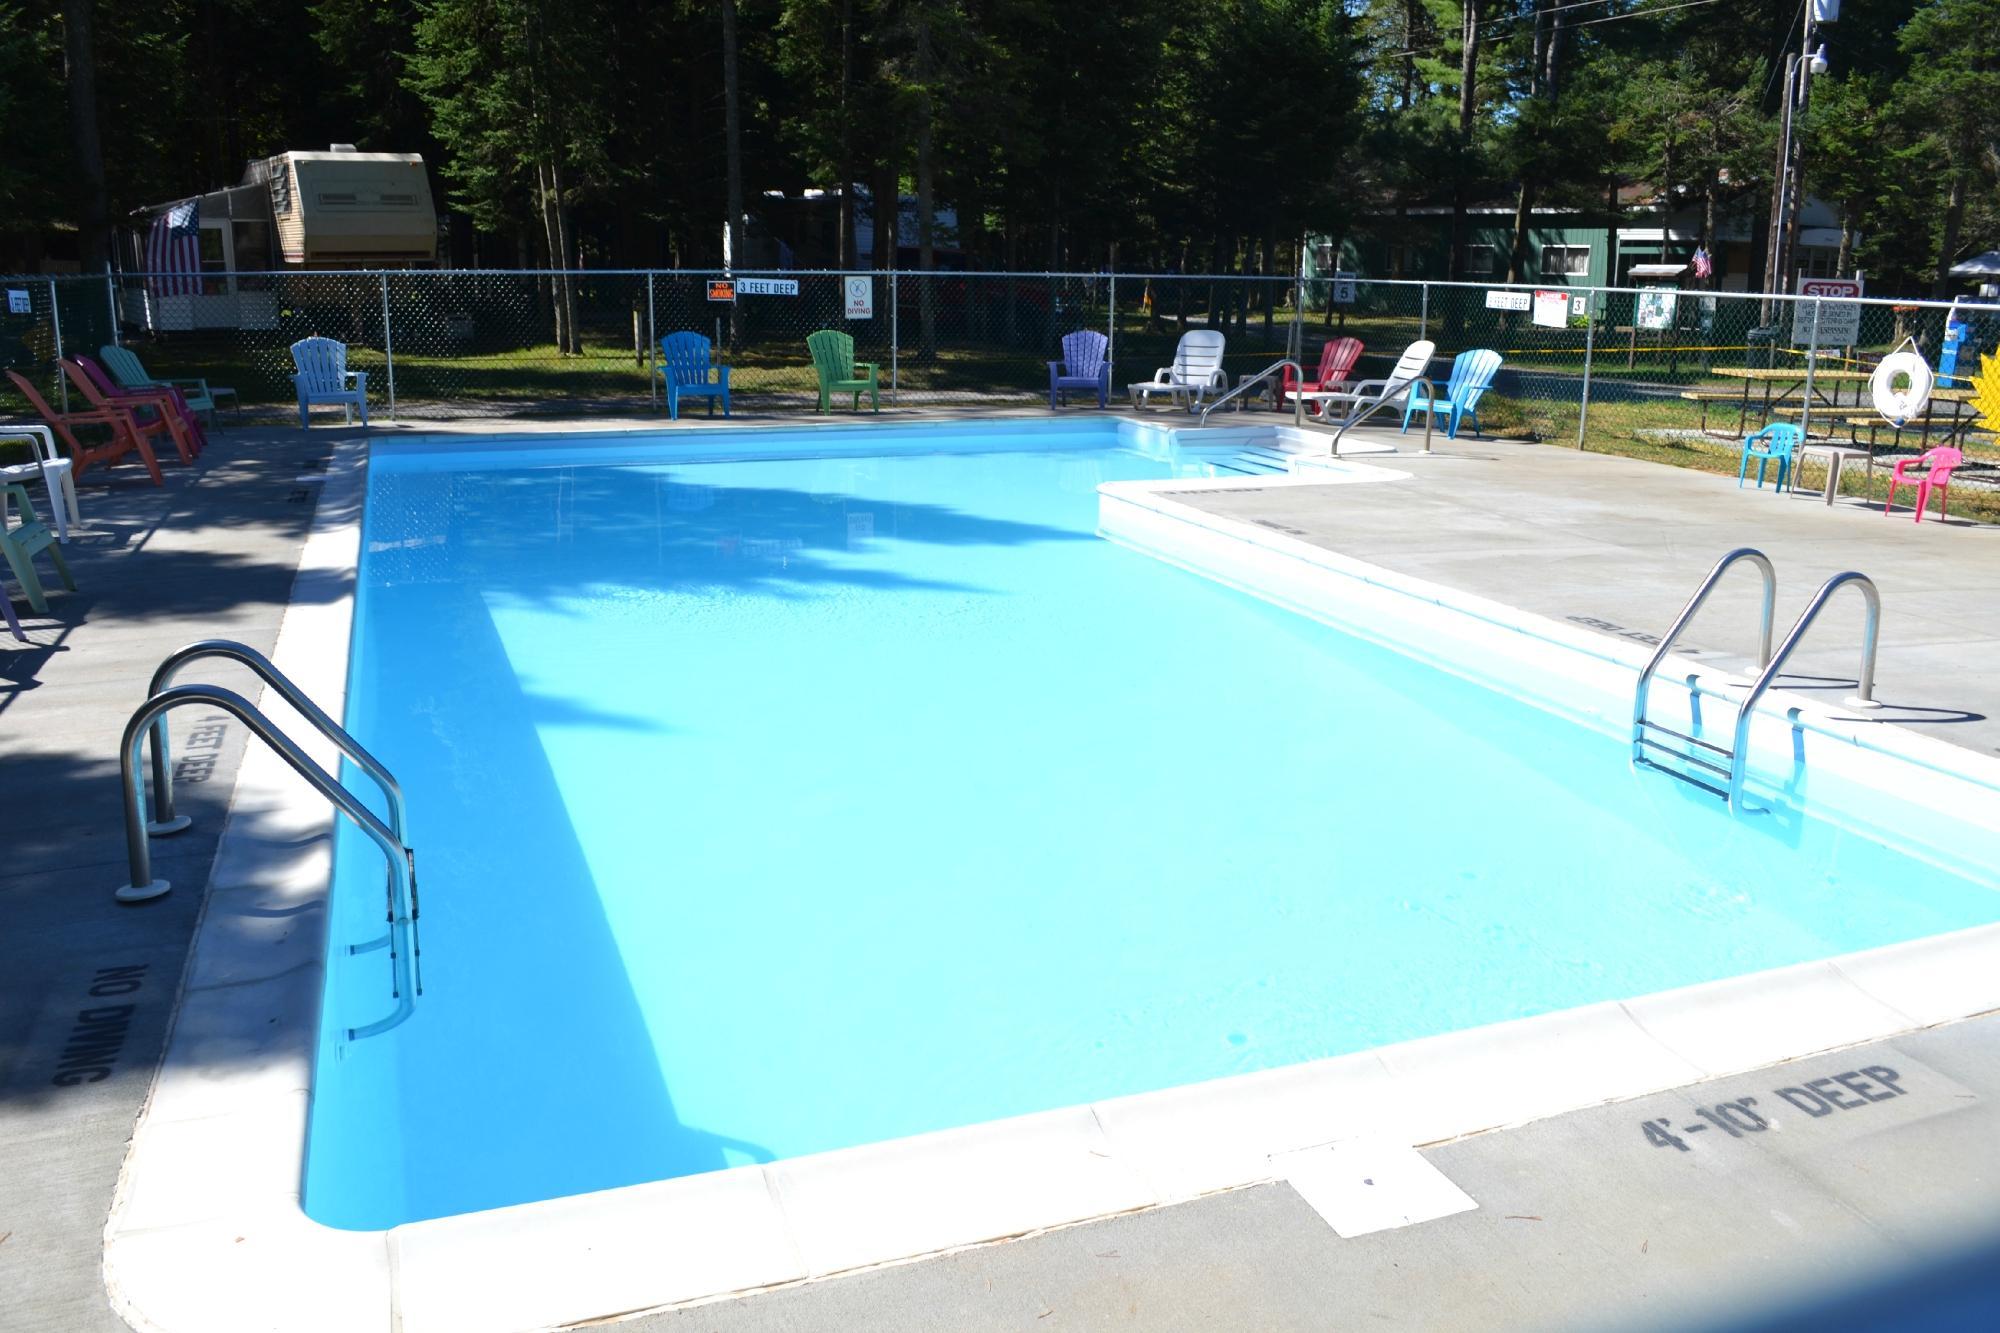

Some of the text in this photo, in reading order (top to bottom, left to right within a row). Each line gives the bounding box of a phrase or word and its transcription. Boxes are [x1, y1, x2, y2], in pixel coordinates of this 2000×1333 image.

[740, 282, 795, 294] 3 FEET DEEP
[1340, 287, 1349, 299] 5
[1807, 285, 1854, 298] STOP
[1510, 297, 1528, 309] DEEP
[1574, 300, 1581, 312] 3
[847, 307, 871, 315] DIVING
[185, 724, 228, 750] FEET
[172, 753, 219, 783] DEEP
[52, 963, 150, 1087] NO DIVING
[1774, 1065, 1909, 1118] DEEP
